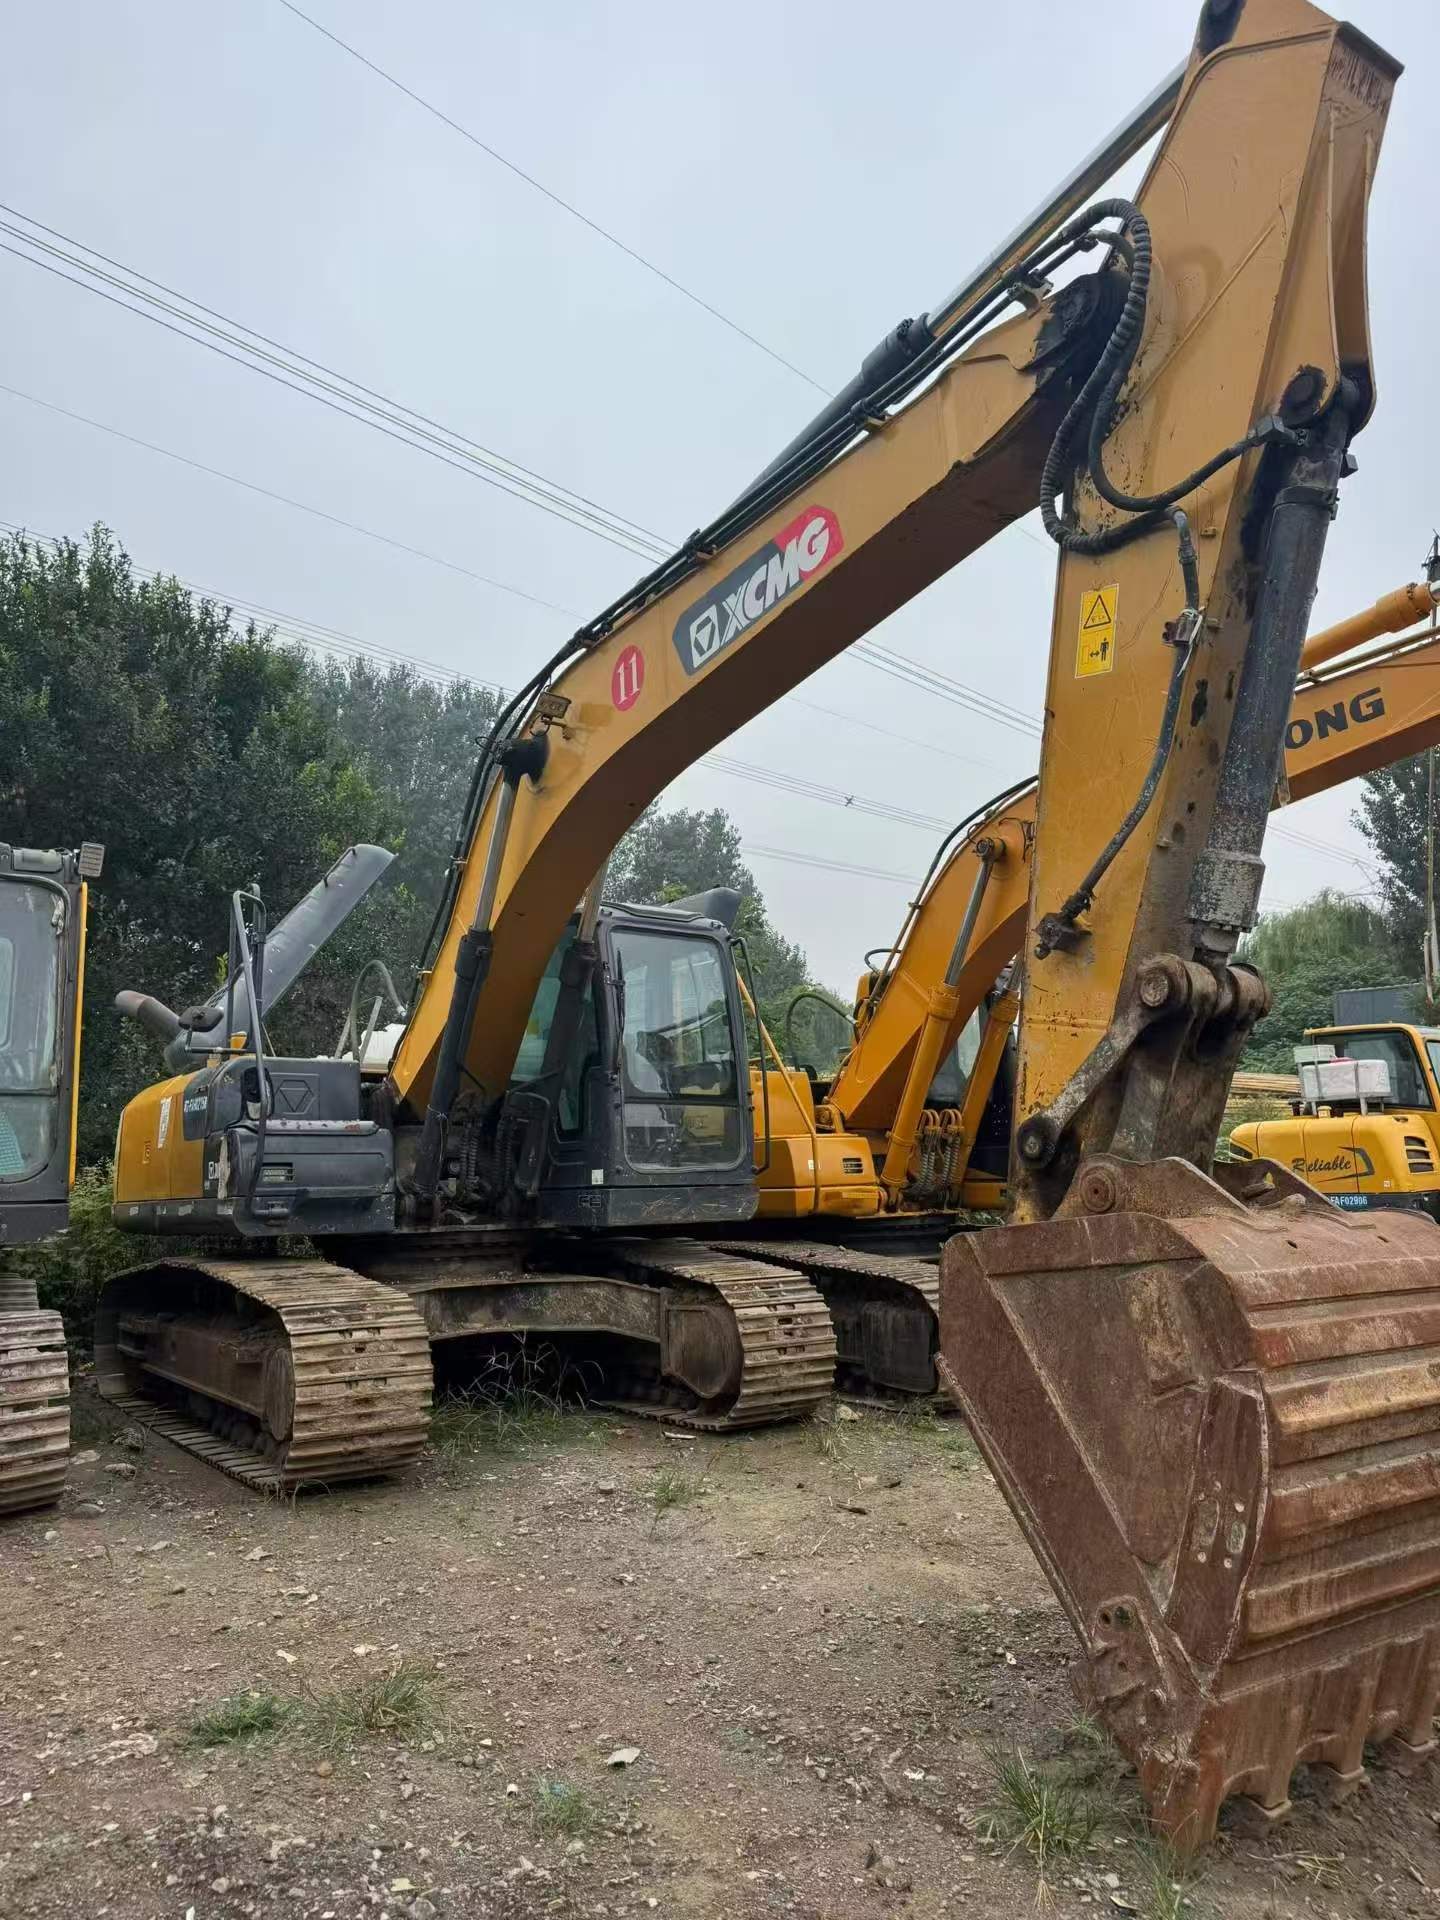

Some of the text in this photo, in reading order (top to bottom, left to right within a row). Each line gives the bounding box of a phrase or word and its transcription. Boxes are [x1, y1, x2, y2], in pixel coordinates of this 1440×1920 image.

[720, 516, 830, 646] XCMG
[617, 652, 641, 705] 11
[1284, 687, 1385, 750] ONG
[1291, 1155, 1352, 1172] Reliable
